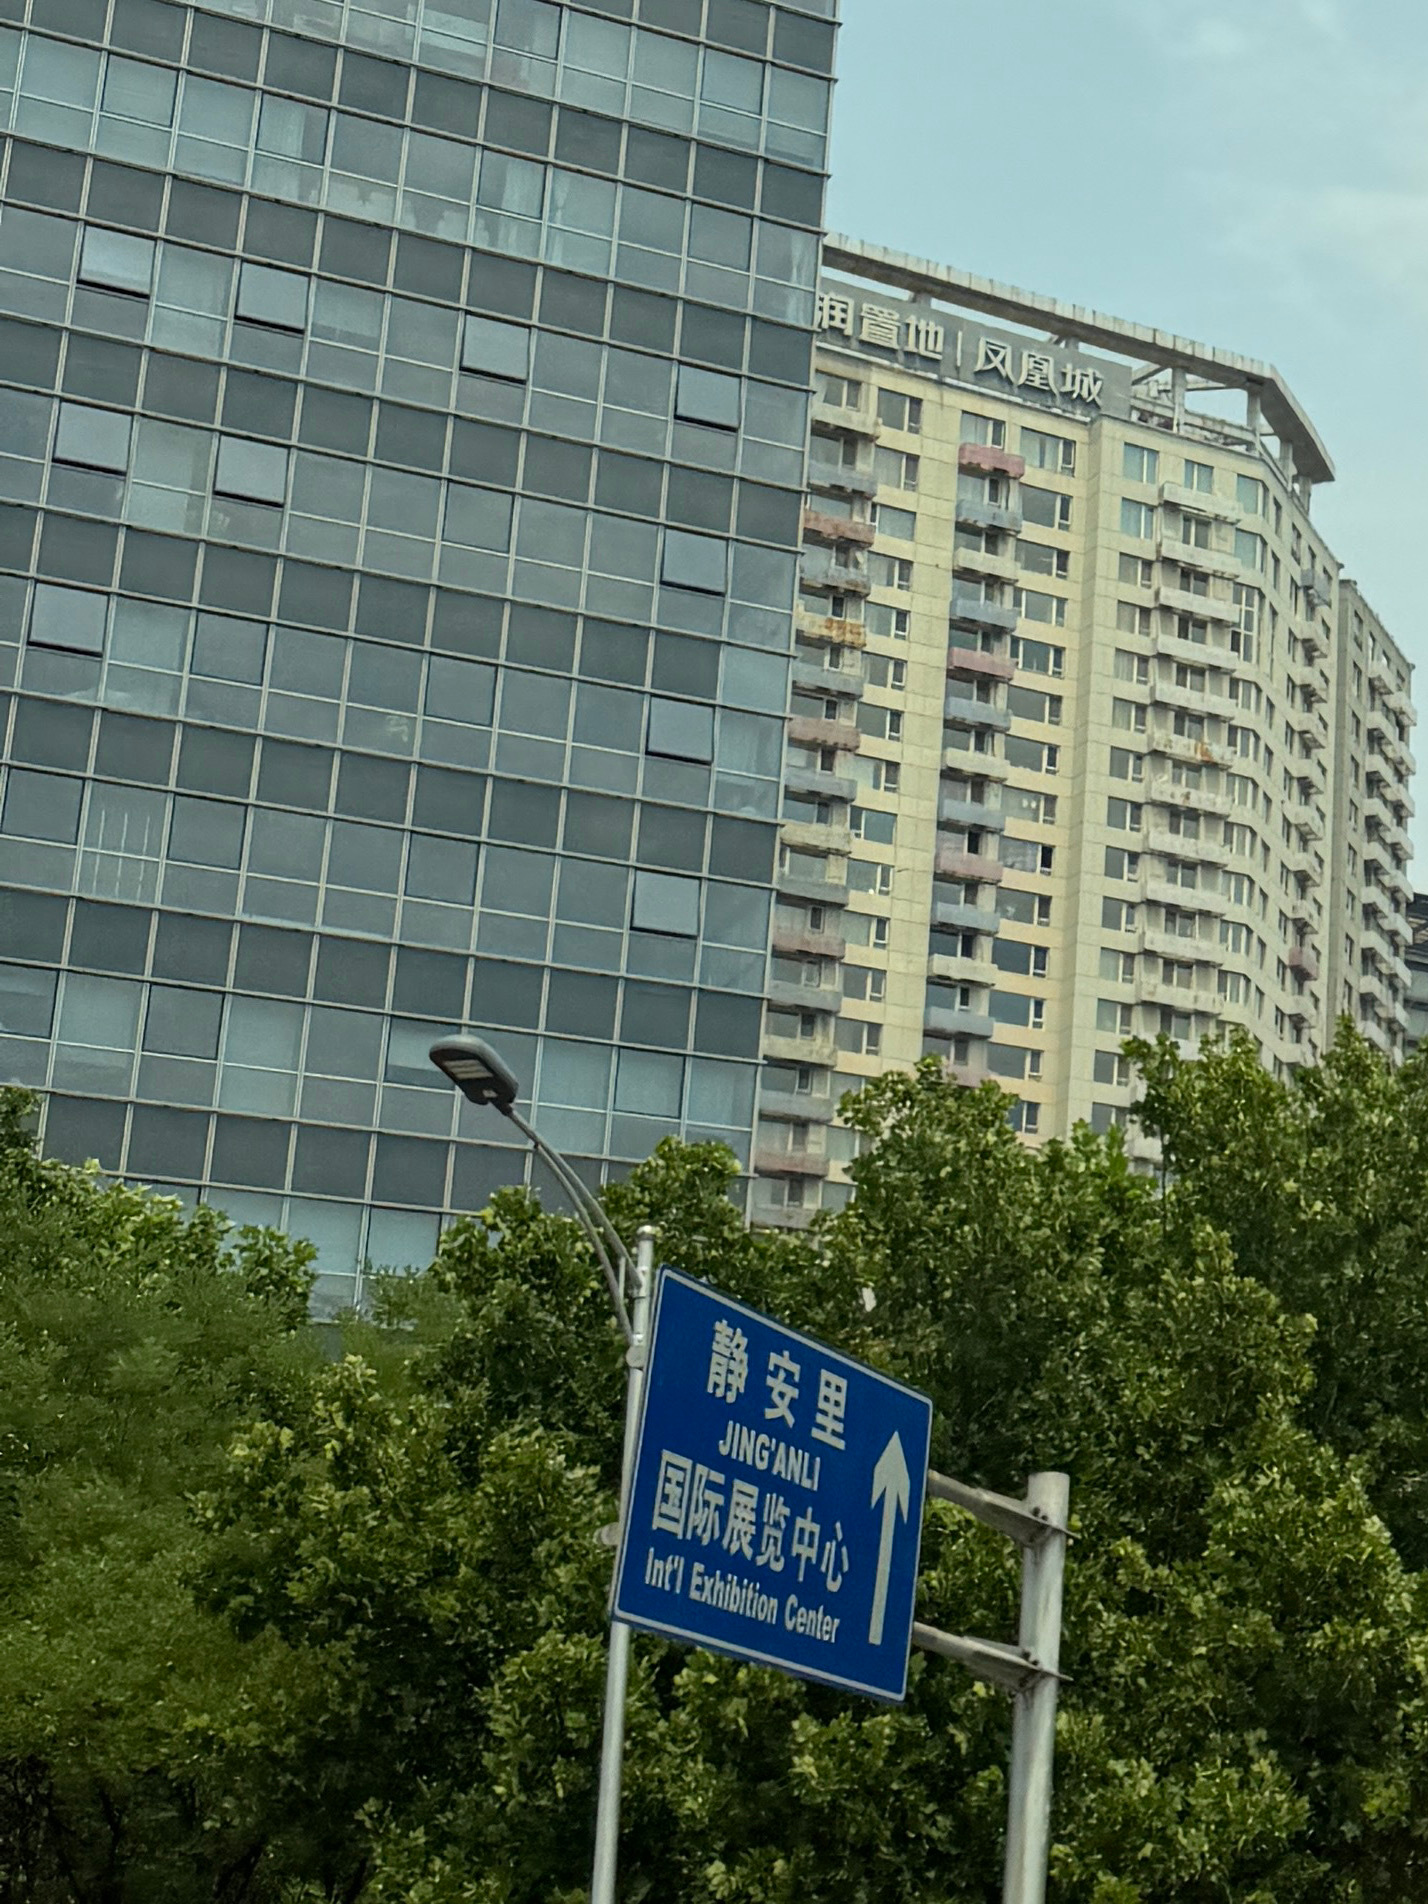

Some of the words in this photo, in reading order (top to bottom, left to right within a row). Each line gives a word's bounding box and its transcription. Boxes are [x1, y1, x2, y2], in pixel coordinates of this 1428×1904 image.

[973, 336, 1104, 407] 凤凰城
[707, 1318, 849, 1451] 静安里
[718, 1420, 821, 1492] JING'ANLI
[651, 1448, 850, 1593] 国际展览中心
[644, 1546, 685, 1595] Int'l
[688, 1561, 779, 1626] Exhibition
[784, 1593, 841, 1644] Center
